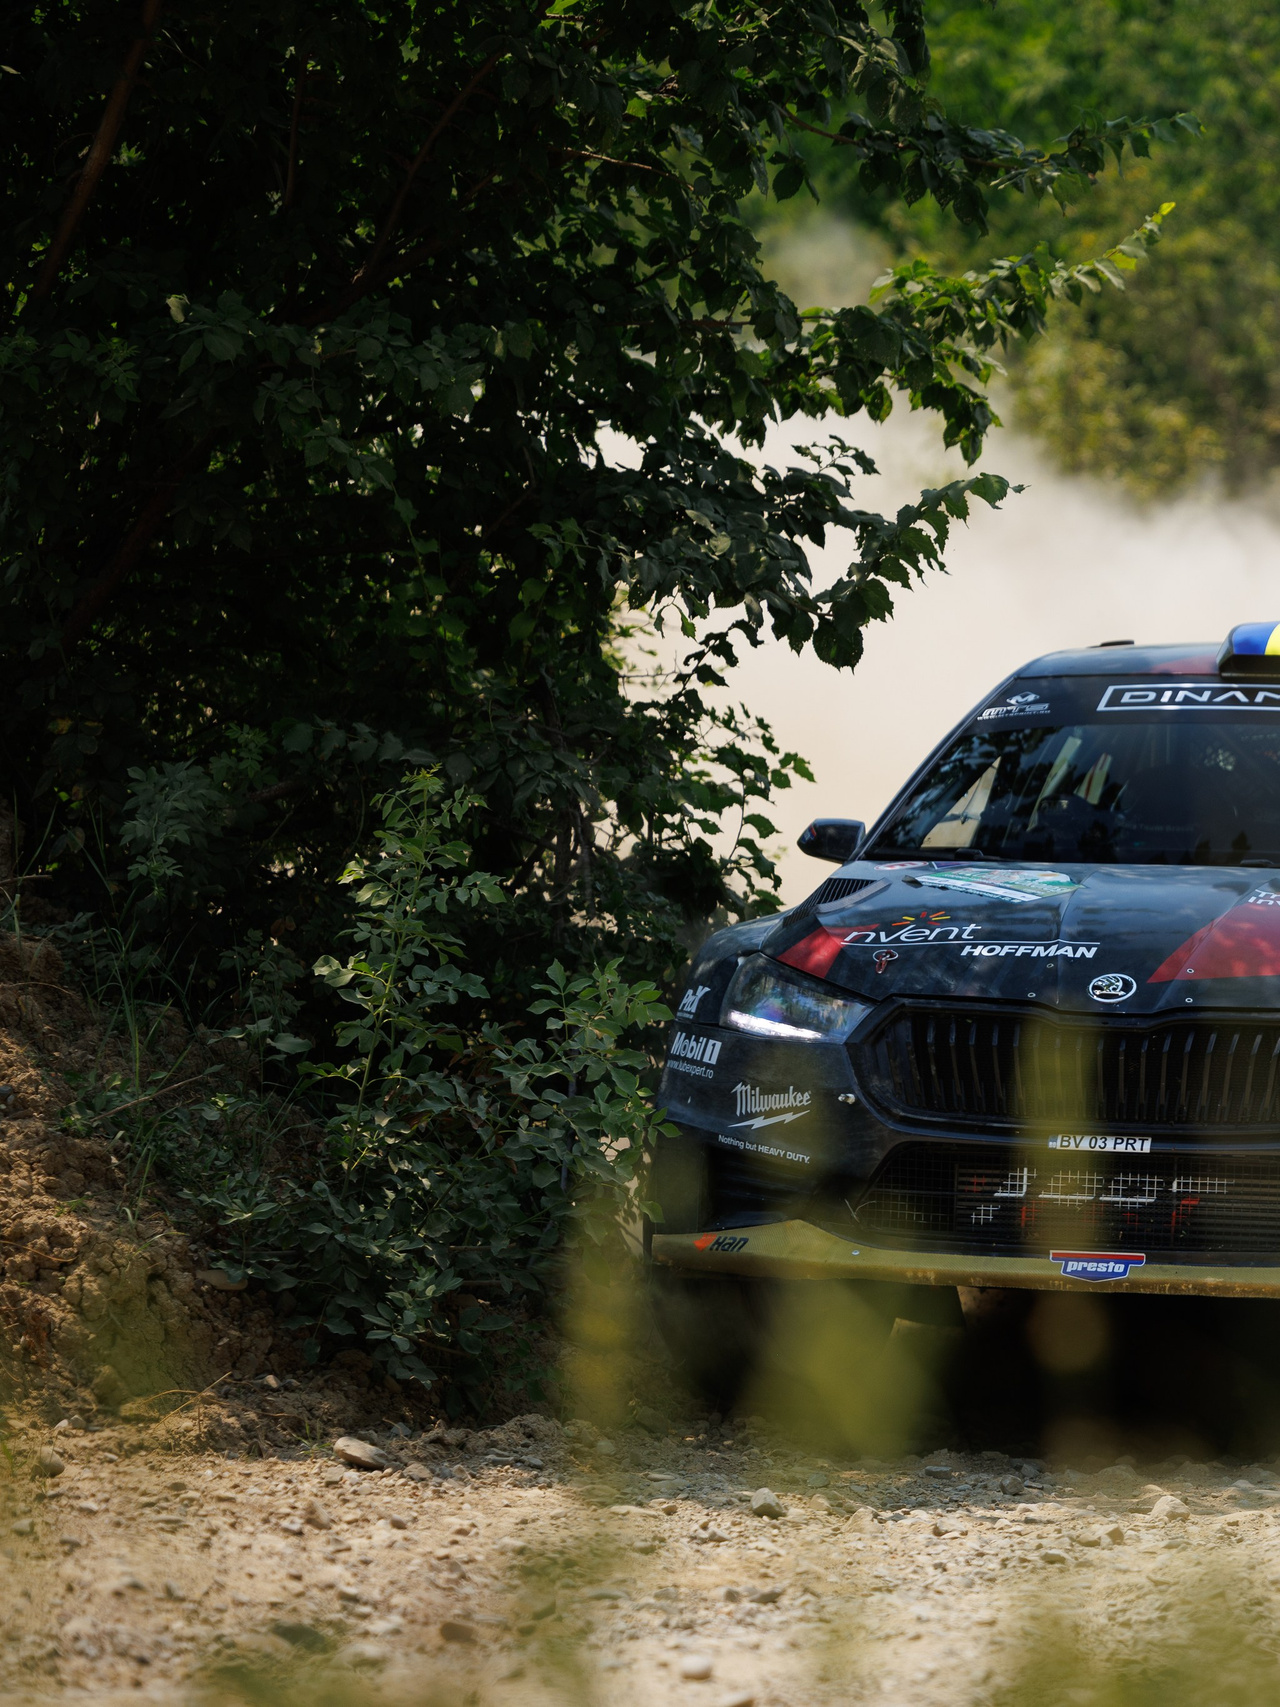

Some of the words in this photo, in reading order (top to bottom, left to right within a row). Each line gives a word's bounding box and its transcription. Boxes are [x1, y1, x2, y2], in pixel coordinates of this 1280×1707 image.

[960, 944, 1098, 959] HOFFMAN
[670, 1031, 707, 1061] Mobil
[666, 1058, 714, 1079] www.lubexpert.ro
[730, 1081, 812, 1117] Milwaukee
[718, 1134, 744, 1150] Nothing
[745, 1141, 757, 1151] but
[758, 1144, 785, 1158] HEAVY
[1060, 1135, 1084, 1149] BV
[1088, 1136, 1107, 1150] 03
[1113, 1137, 1149, 1151] PRT
[1066, 1261, 1125, 1273] presto
